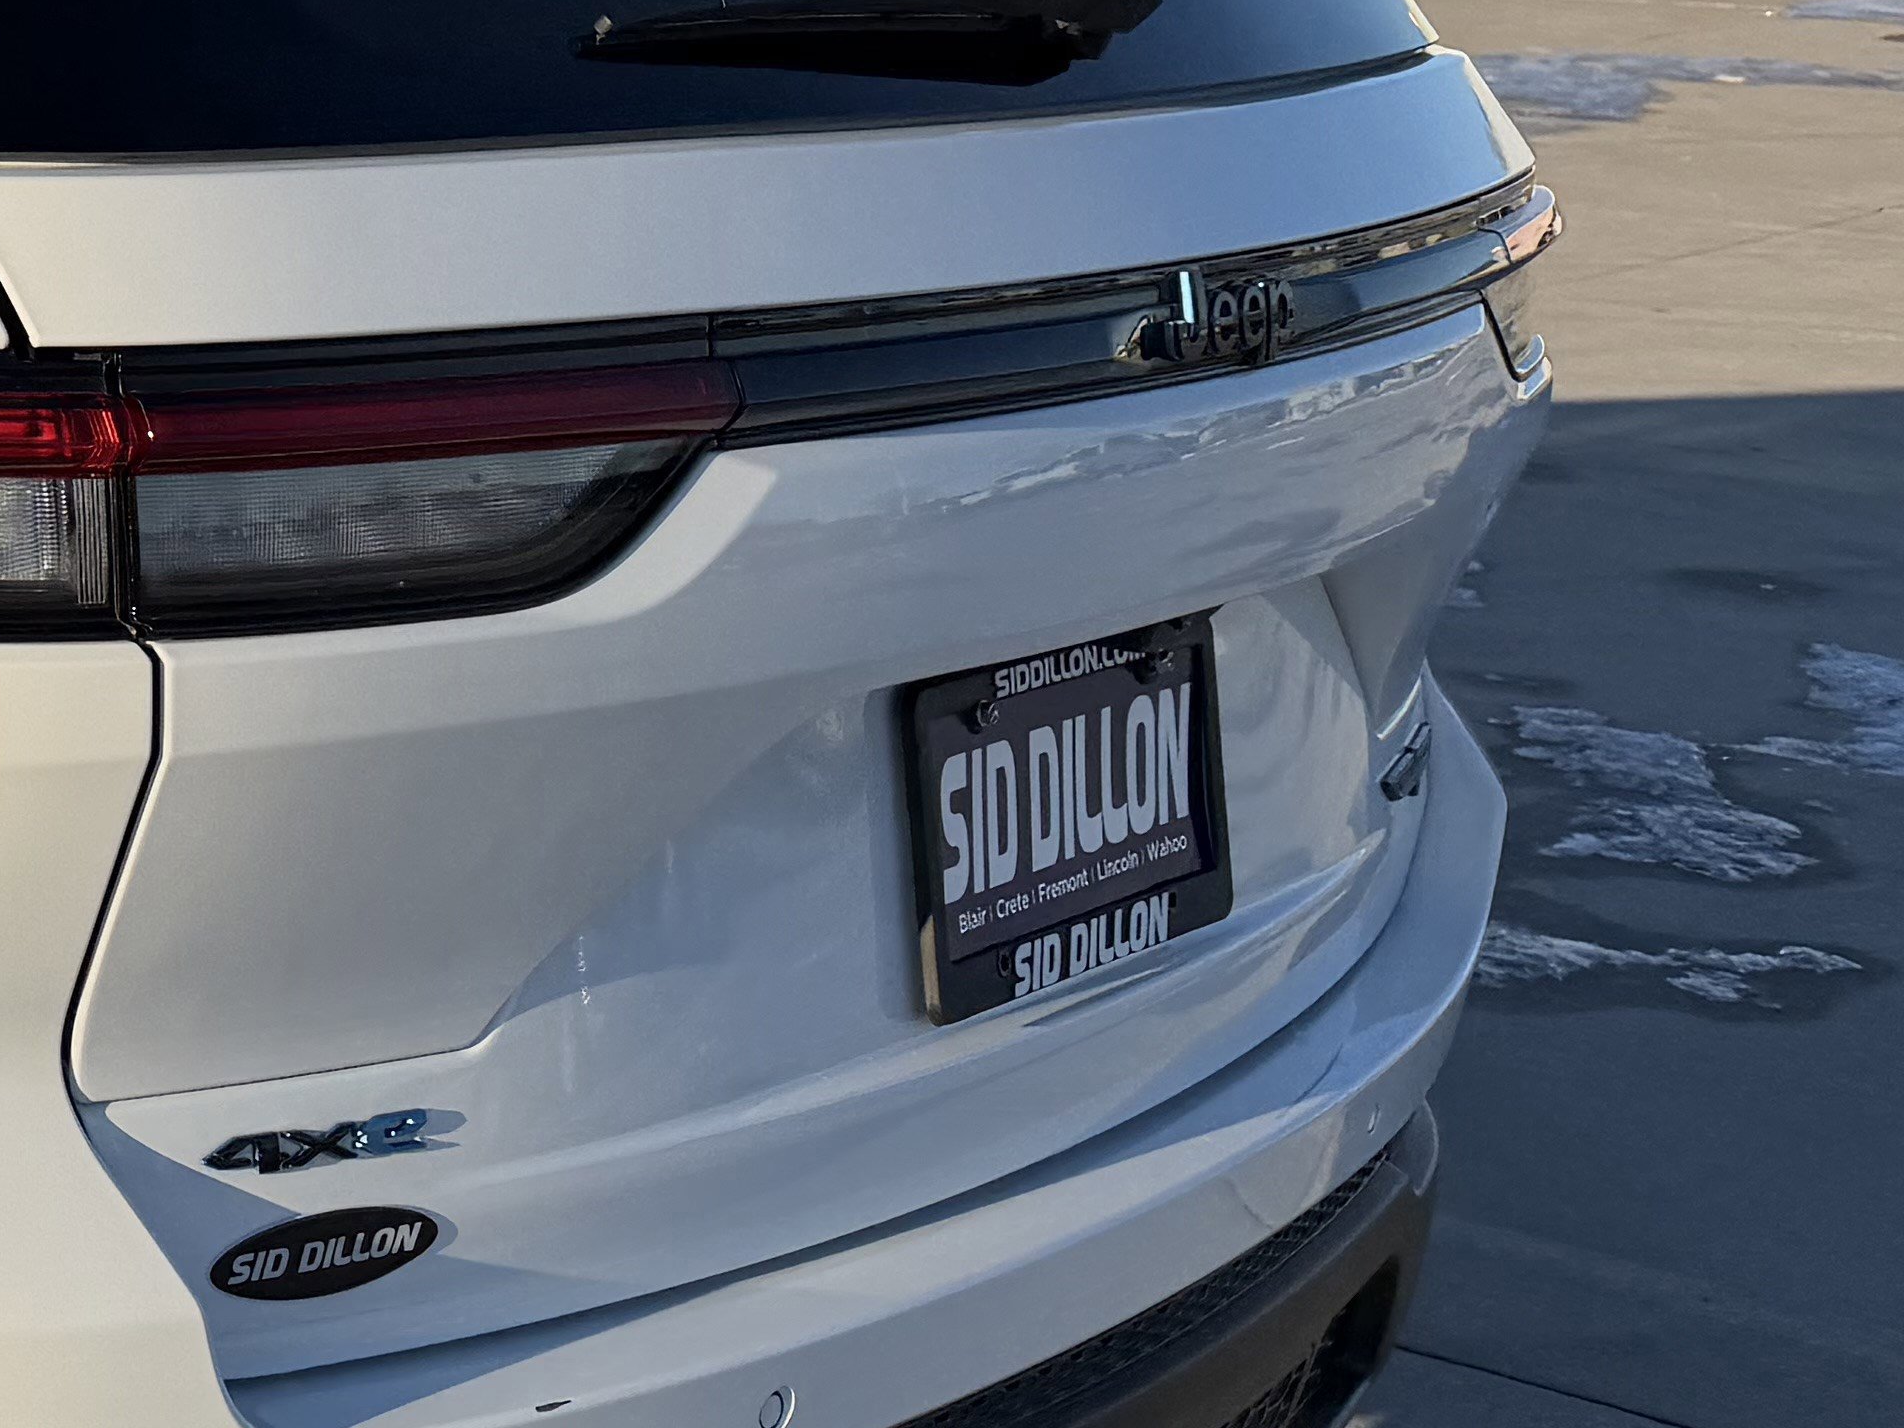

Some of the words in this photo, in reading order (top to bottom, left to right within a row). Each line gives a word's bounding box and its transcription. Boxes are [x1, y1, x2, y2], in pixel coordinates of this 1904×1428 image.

[1178, 264, 1294, 365] Jeep
[940, 737, 1018, 905] SID
[1029, 681, 1191, 872] DILLON
[958, 909, 987, 934] Blair
[996, 891, 1029, 919] Crete
[1038, 870, 1090, 904] Fremont
[1096, 850, 1140, 881] Lincoln
[1146, 834, 1188, 862] Wahoo
[1014, 932, 1063, 998] SID
[1068, 891, 1170, 978] DILLON
[227, 1247, 290, 1286] SID
[297, 1222, 423, 1274] DILLON
